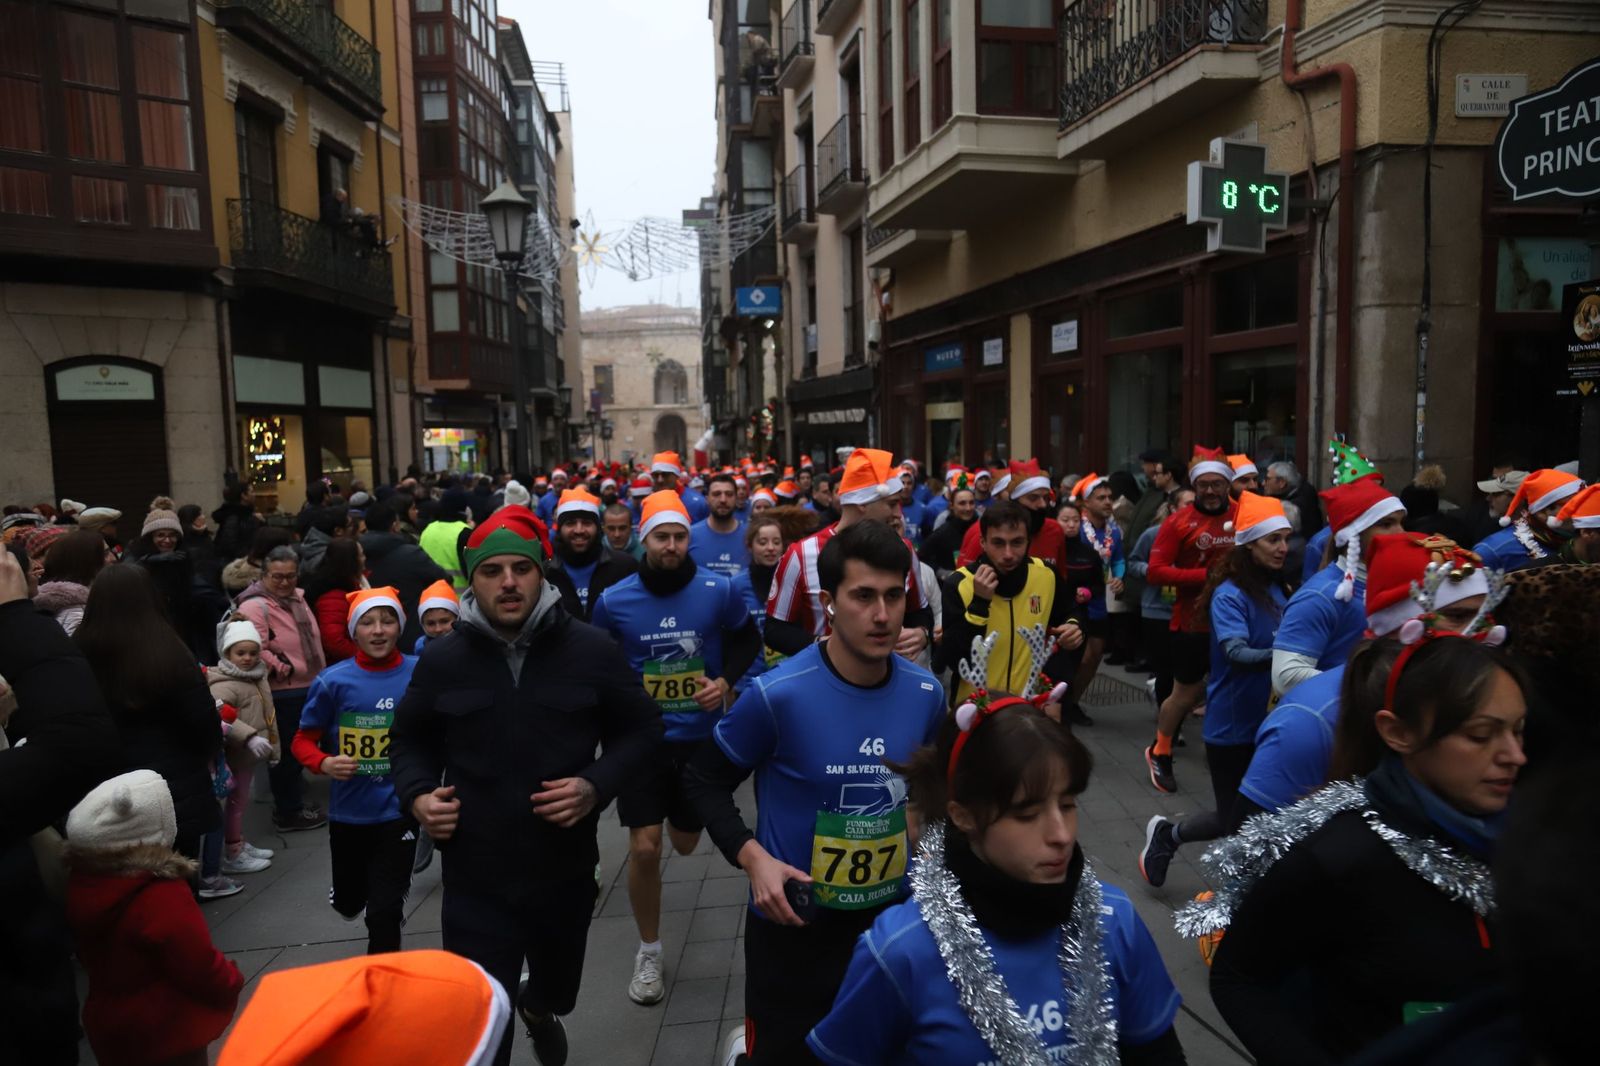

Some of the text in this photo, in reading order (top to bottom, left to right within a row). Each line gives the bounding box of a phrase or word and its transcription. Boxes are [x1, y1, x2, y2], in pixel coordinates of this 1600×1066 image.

[1481, 80, 1511, 89] CALLE
[1486, 92, 1499, 100] DE
[1540, 95, 1600, 136] TEAT
[1222, 180, 1238, 210] 8
[1570, 267, 1587, 281] de
[719, 553, 731, 562] 46
[660, 616, 677, 629] 46
[647, 677, 696, 699] 786
[375, 697, 394, 710] 46
[343, 733, 393, 758] 582
[859, 737, 886, 756] 46
[826, 765, 844, 775] SAN
[845, 825, 889, 835] CAJA RURAL
[821, 844, 898, 885] 787
[838, 885, 897, 903] CAJA RURAL
[1024, 1000, 1063, 1034] 46
